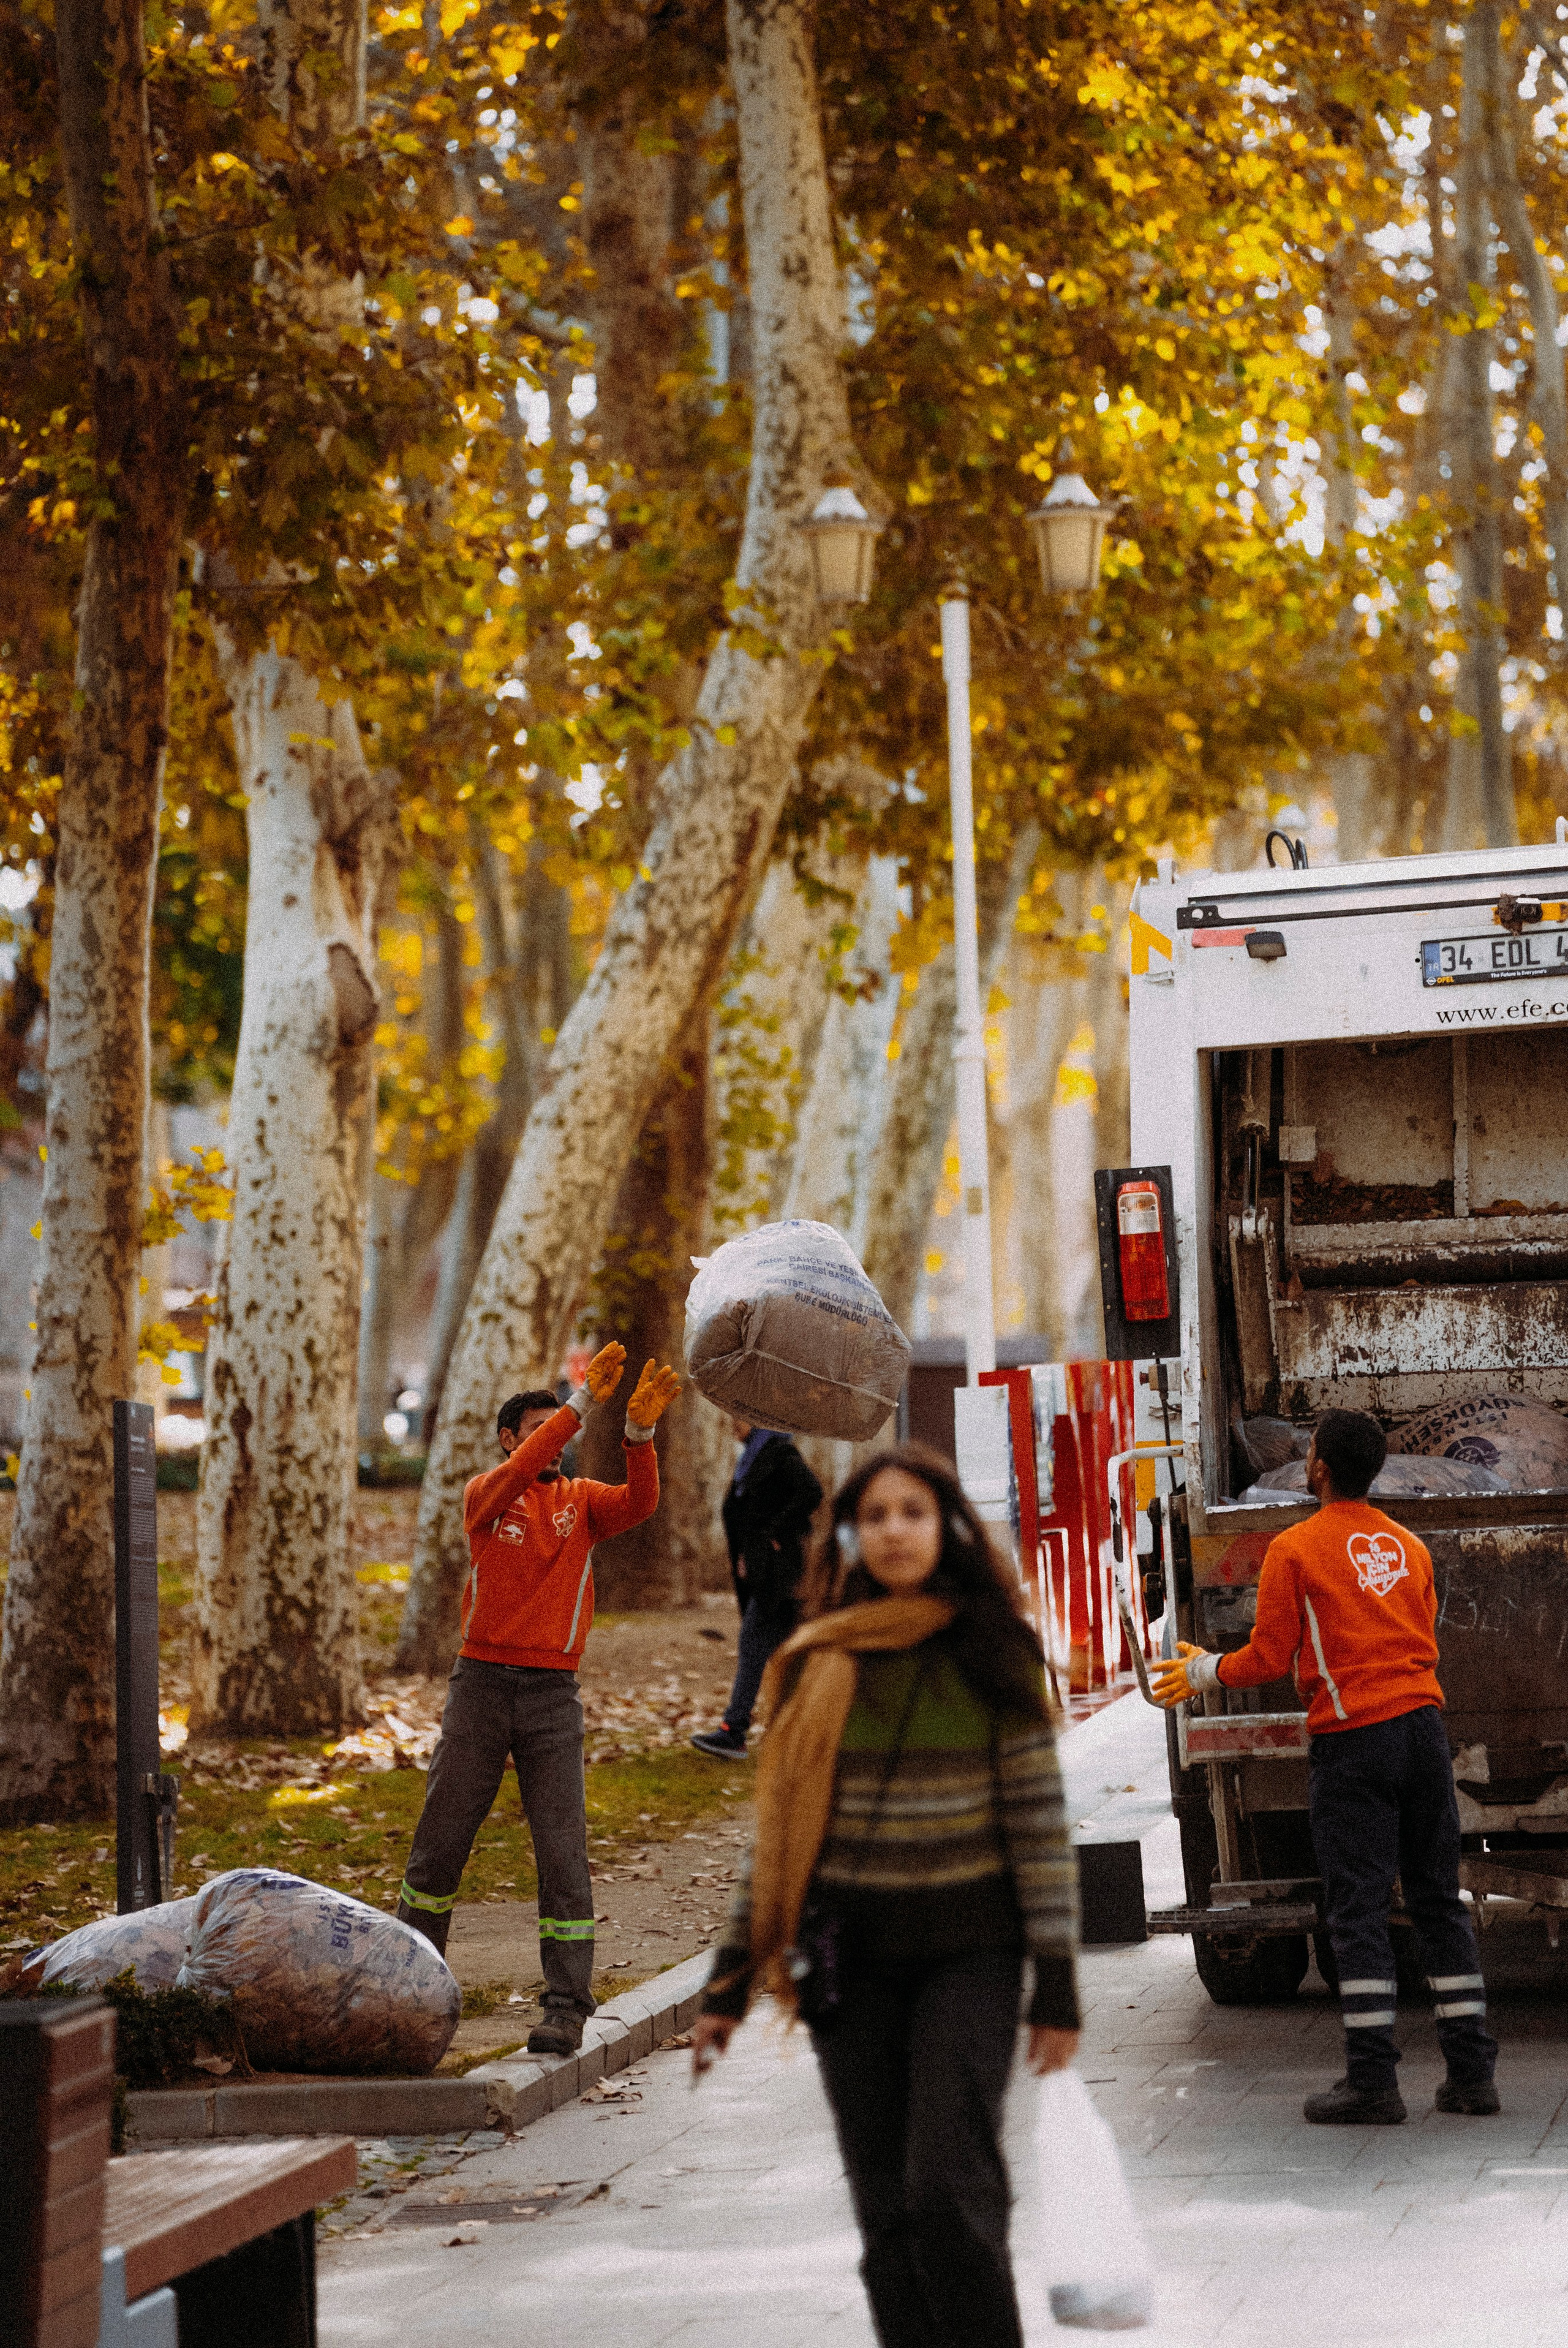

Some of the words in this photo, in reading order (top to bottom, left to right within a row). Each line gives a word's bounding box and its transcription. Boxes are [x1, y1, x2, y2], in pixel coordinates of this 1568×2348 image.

[1428, 962, 1439, 971] TR
[1442, 945, 1473, 972] 34
[1491, 938, 1540, 968] EDL
[1436, 998, 1568, 1024] www.efe.c
